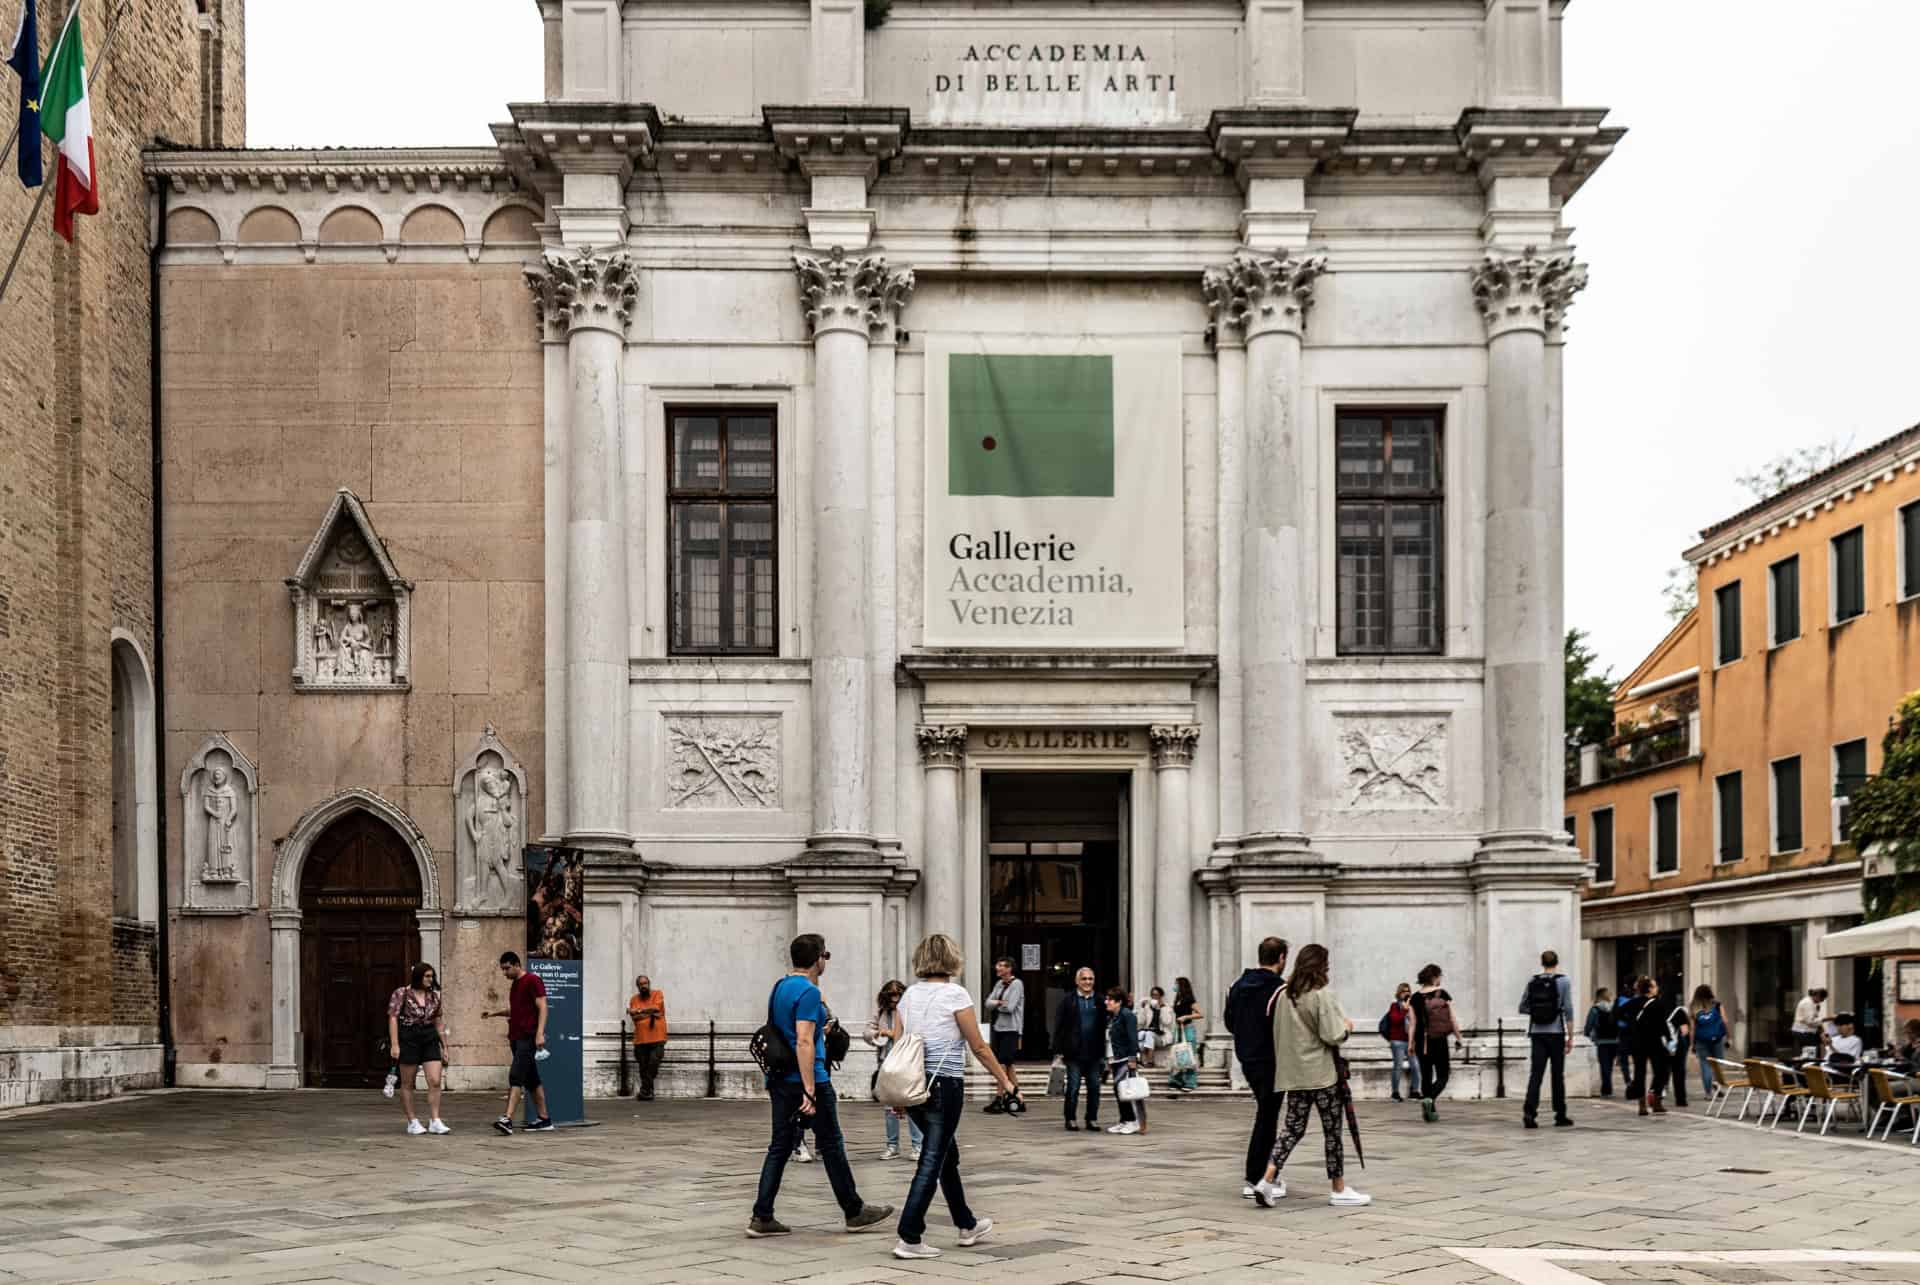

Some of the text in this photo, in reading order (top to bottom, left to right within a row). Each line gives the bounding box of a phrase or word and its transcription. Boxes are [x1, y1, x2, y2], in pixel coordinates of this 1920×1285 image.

[965, 44, 1146, 62] ACCADEMIA
[935, 74, 1176, 92] DI BELLE ARTI
[949, 531, 1076, 561] Gallerie
[948, 565, 1134, 597] Accademia,
[949, 599, 1074, 626] Venezia
[983, 730, 1130, 749] GALLERIE
